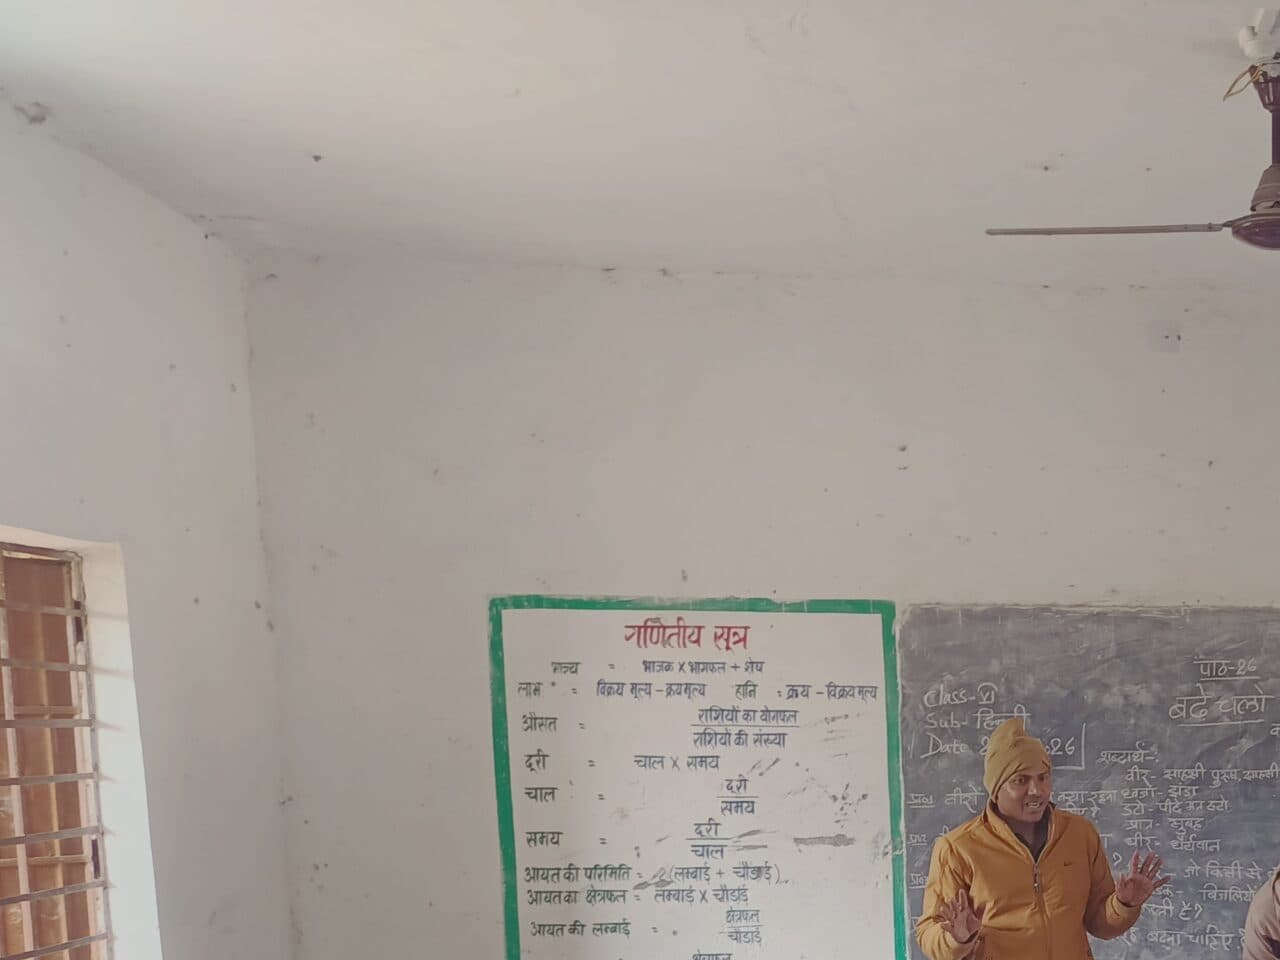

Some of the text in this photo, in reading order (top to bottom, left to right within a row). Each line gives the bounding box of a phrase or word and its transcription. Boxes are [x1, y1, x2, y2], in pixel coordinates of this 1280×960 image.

[714, 625, 751, 652] सूत्र
[522, 711, 558, 733] औसत
[752, 728, 789, 749] संख्या
[524, 749, 550, 772] दूरी
[634, 755, 666, 771] चाल
[686, 755, 720, 771] समय
[525, 786, 559, 803] चाल
[720, 800, 756, 816] समय
[526, 831, 563, 847] समय
[690, 844, 729, 860] चाल
[585, 885, 629, 907] क्षेत्रफल
